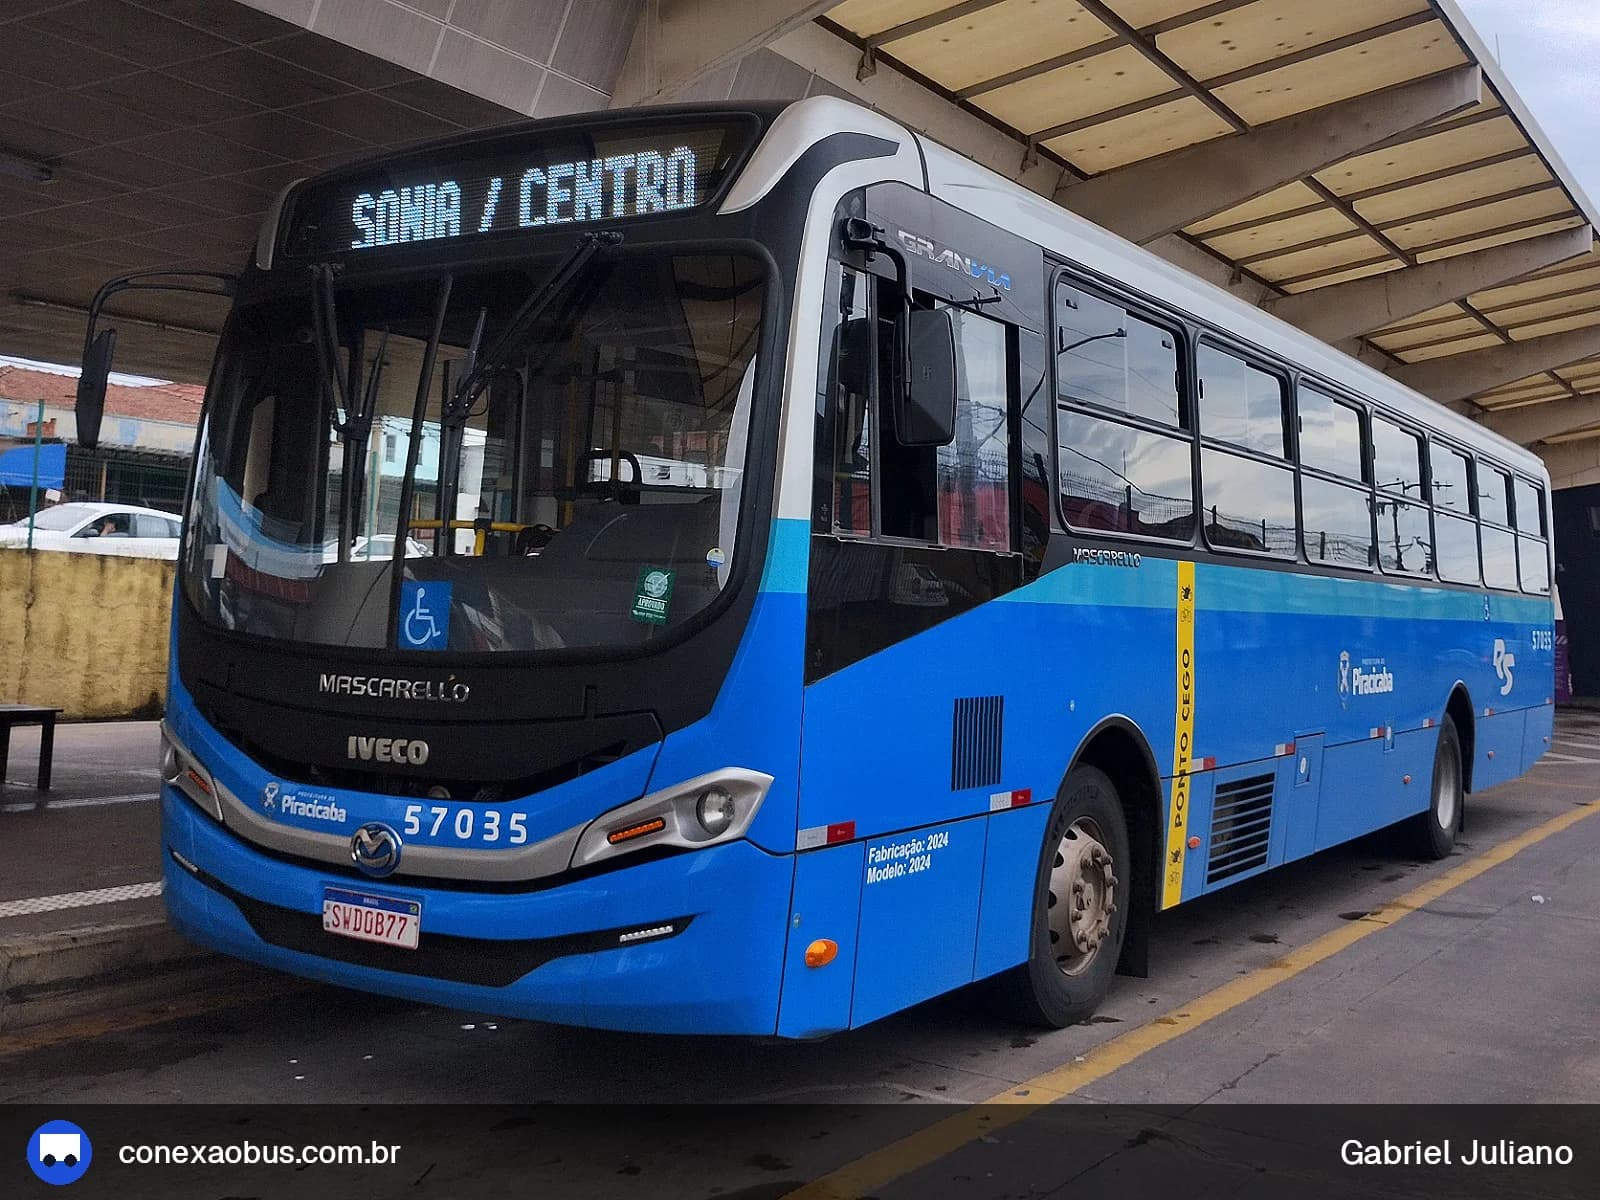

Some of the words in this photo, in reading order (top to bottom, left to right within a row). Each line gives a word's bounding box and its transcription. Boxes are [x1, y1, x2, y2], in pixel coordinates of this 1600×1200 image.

[351, 180, 461, 249] SONIA
[519, 145, 696, 227] CENTRO
[1072, 547, 1142, 568] MASCARELLO
[319, 673, 470, 703] MASCARELLO
[1352, 666, 1393, 696] Piracicaba
[347, 735, 430, 765] IVECO
[1174, 732, 1189, 828] PONTO
[1182, 647, 1191, 722] CEGO
[281, 794, 347, 823] Piracicaba
[404, 804, 528, 845] 57035
[868, 838, 926, 865] Fabricação:
[926, 831, 949, 851] 2024
[866, 861, 907, 885] Modelo:
[908, 853, 931, 874] 2024
